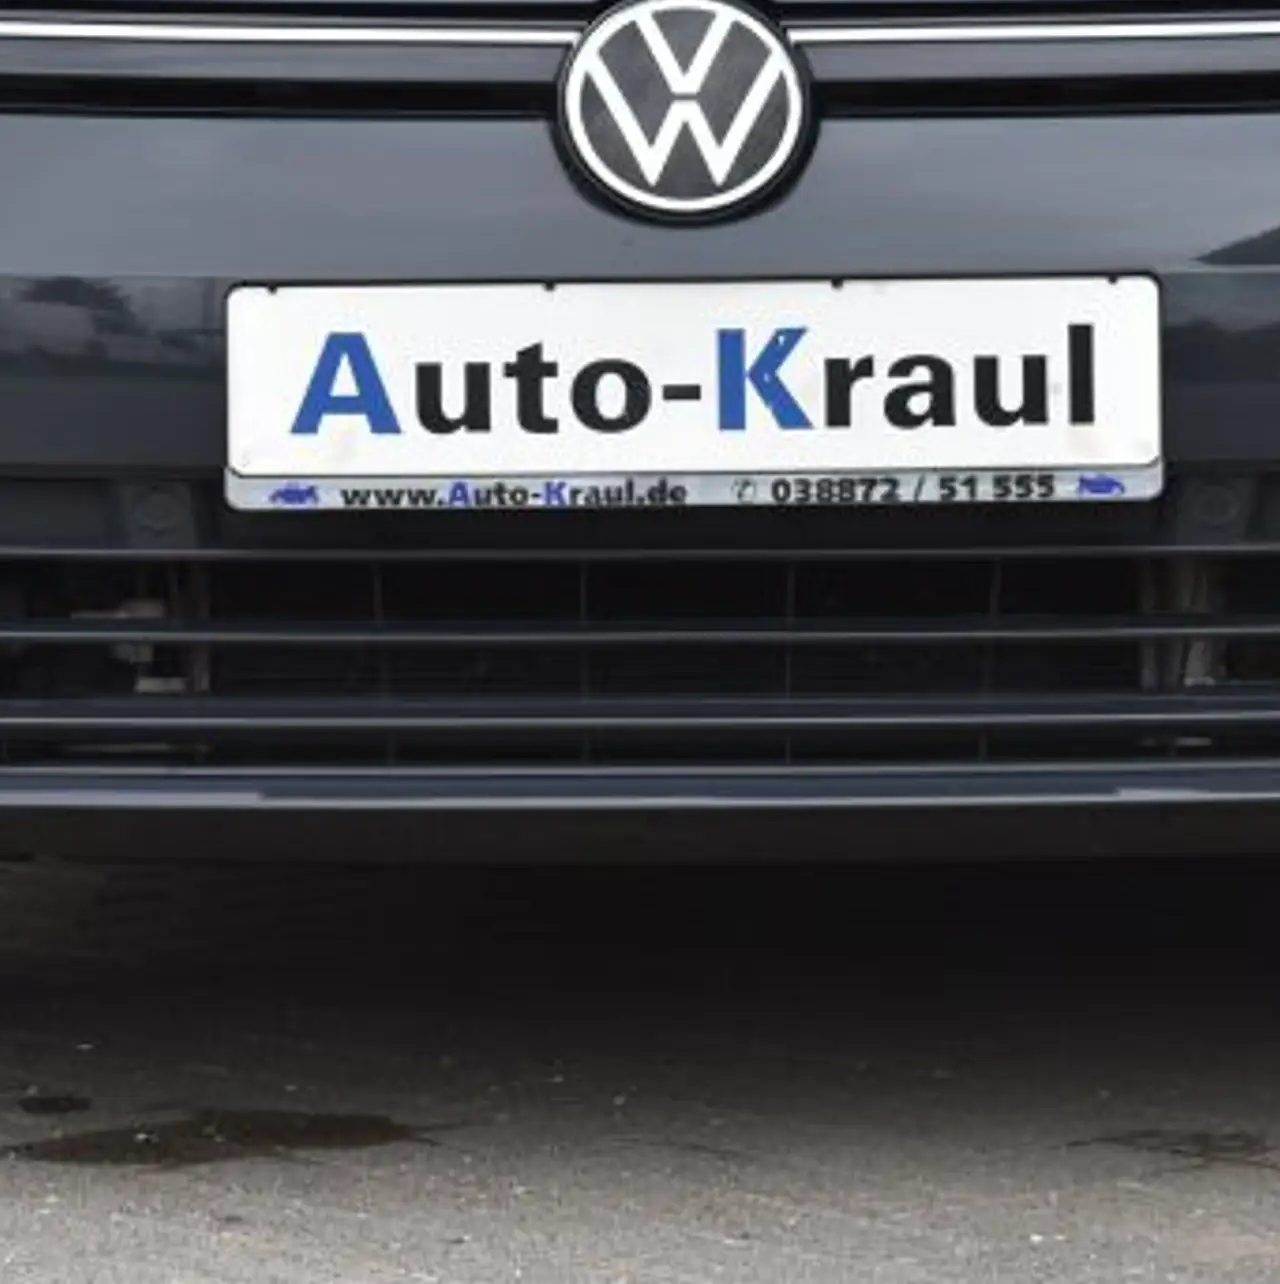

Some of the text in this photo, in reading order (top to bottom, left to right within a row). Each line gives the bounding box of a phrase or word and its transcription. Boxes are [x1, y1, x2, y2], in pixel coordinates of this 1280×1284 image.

[290, 323, 1096, 435] Auto-Kraul
[340, 478, 687, 506] www.Auto-Kraul.de
[771, 476, 900, 504] 038872
[939, 475, 977, 501] 51
[992, 474, 1056, 499] 555
